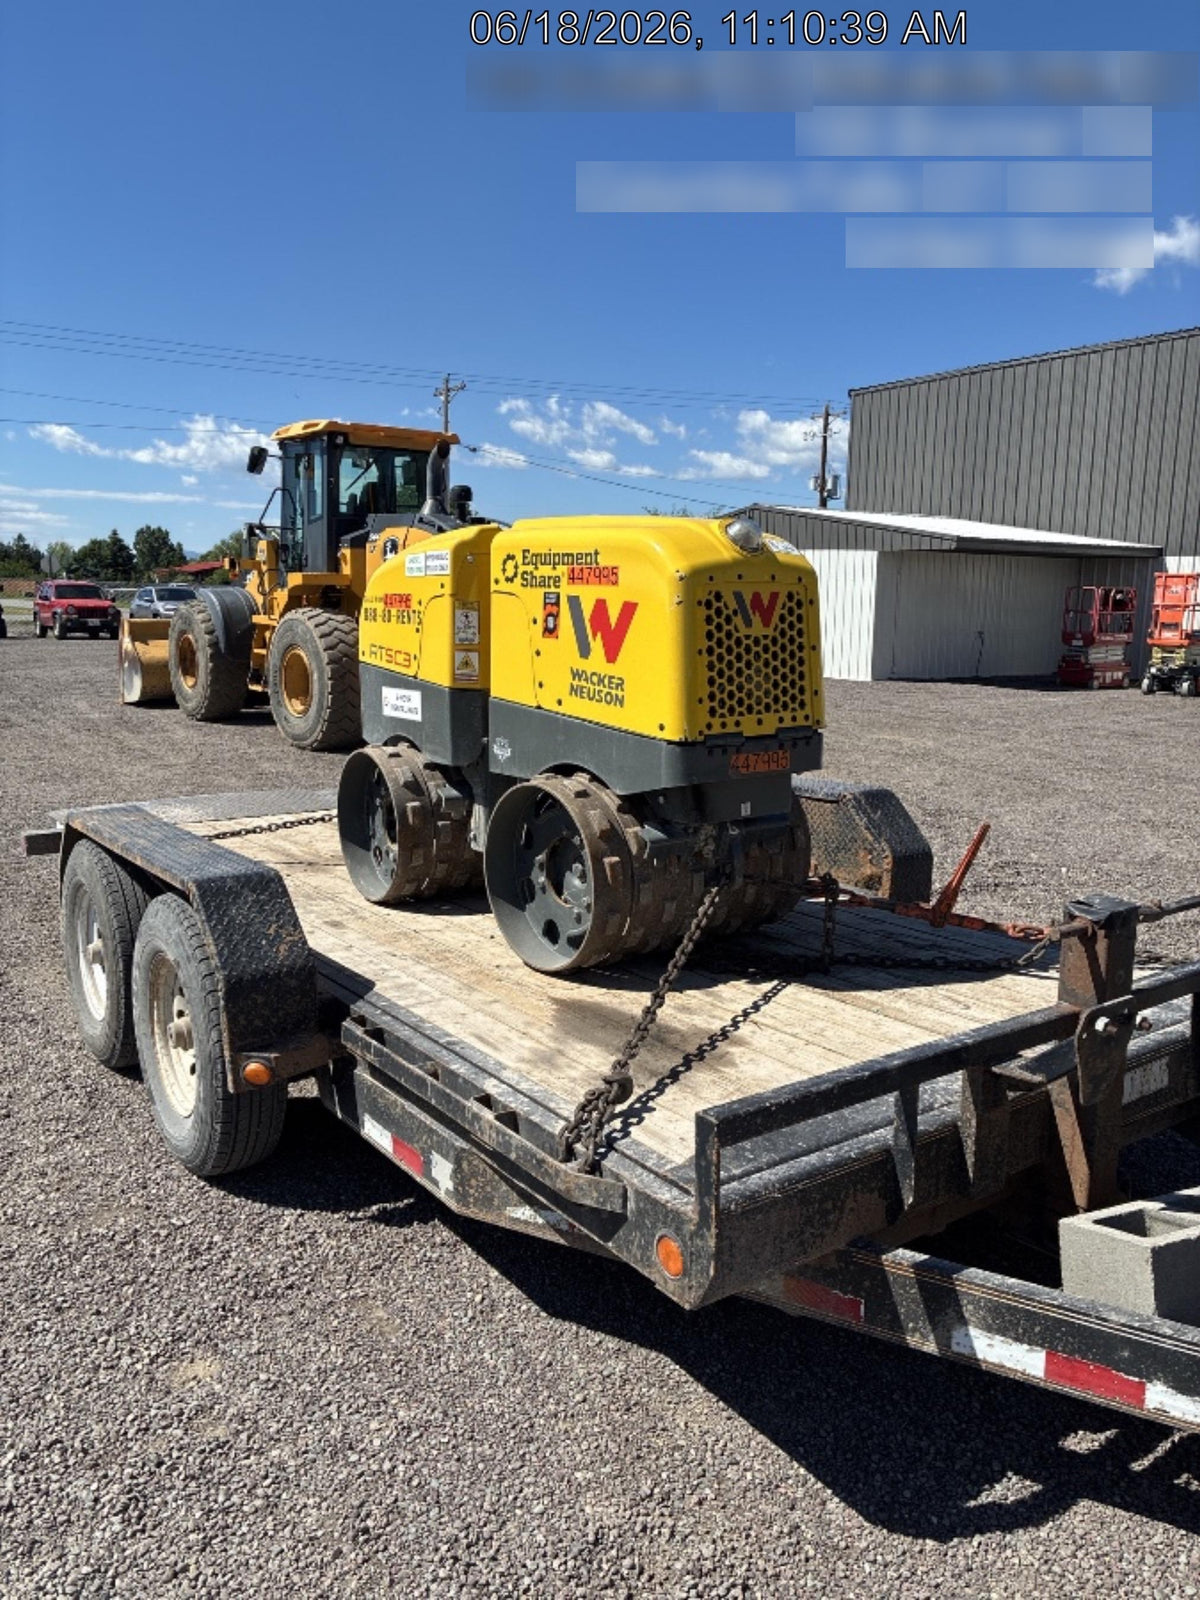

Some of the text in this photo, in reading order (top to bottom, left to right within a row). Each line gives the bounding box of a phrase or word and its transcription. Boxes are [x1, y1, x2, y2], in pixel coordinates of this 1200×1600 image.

[521, 548, 600, 570] Equipment
[520, 570, 561, 589] Share
[568, 566, 619, 586] 447995
[570, 667, 625, 692] WACKER
[569, 682, 625, 708] NEUSON
[730, 751, 789, 771] 447995
